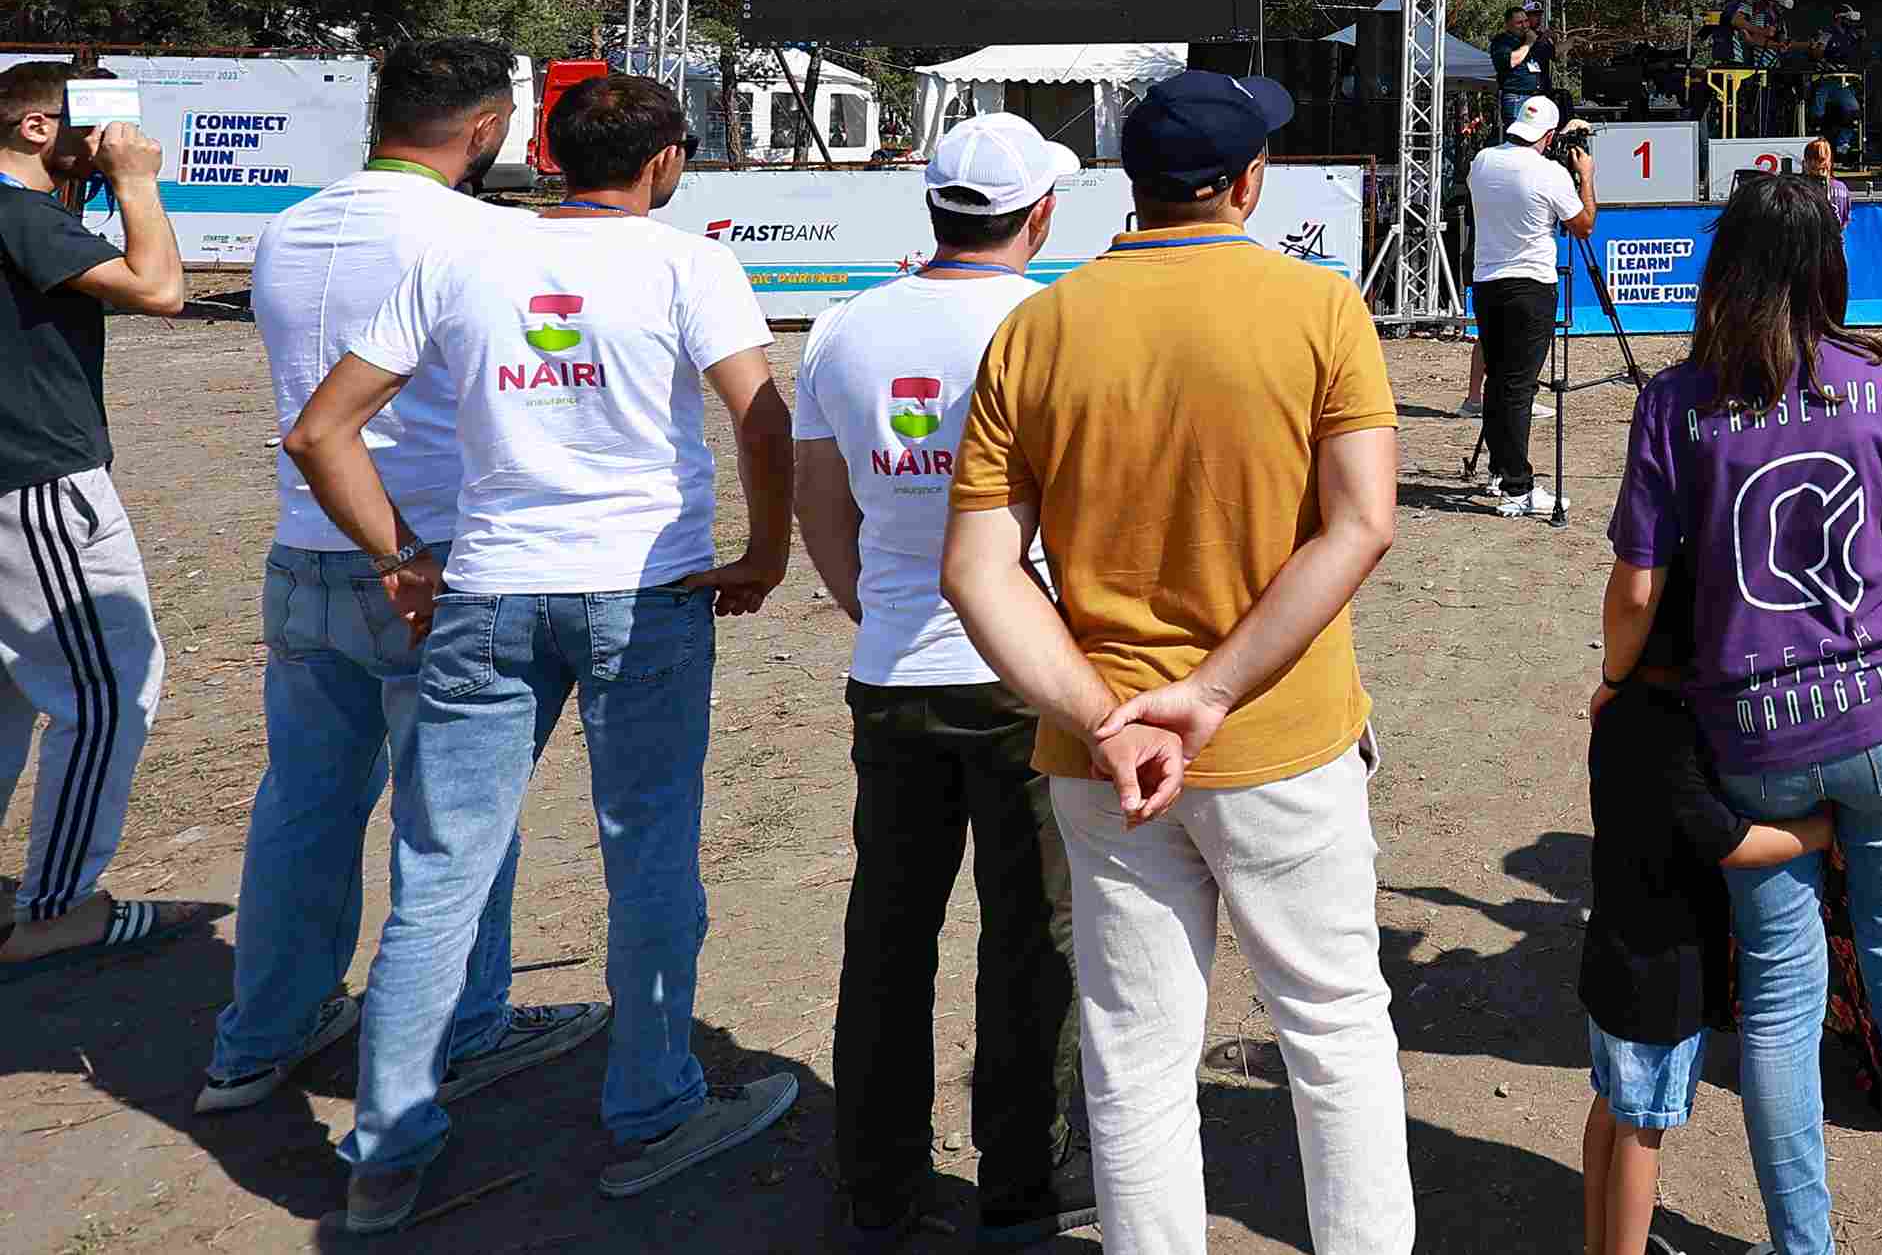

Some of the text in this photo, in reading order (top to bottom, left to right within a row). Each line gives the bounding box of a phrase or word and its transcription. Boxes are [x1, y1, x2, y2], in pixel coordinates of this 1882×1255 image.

[195, 114, 287, 132] CONNECT
[194, 132, 260, 148] LEARN
[192, 150, 234, 165] WIN
[1633, 141, 1651, 179] 1
[190, 168, 289, 184] HAVE FUN
[730, 224, 839, 242] FASTBANK
[1617, 241, 1692, 256] CONNECT
[1617, 257, 1671, 271] LEARN
[1617, 272, 1651, 285] WIN
[1617, 285, 1698, 301] HAVE FUN
[498, 362, 606, 391] NAIRI
[871, 449, 953, 476] NAIR
